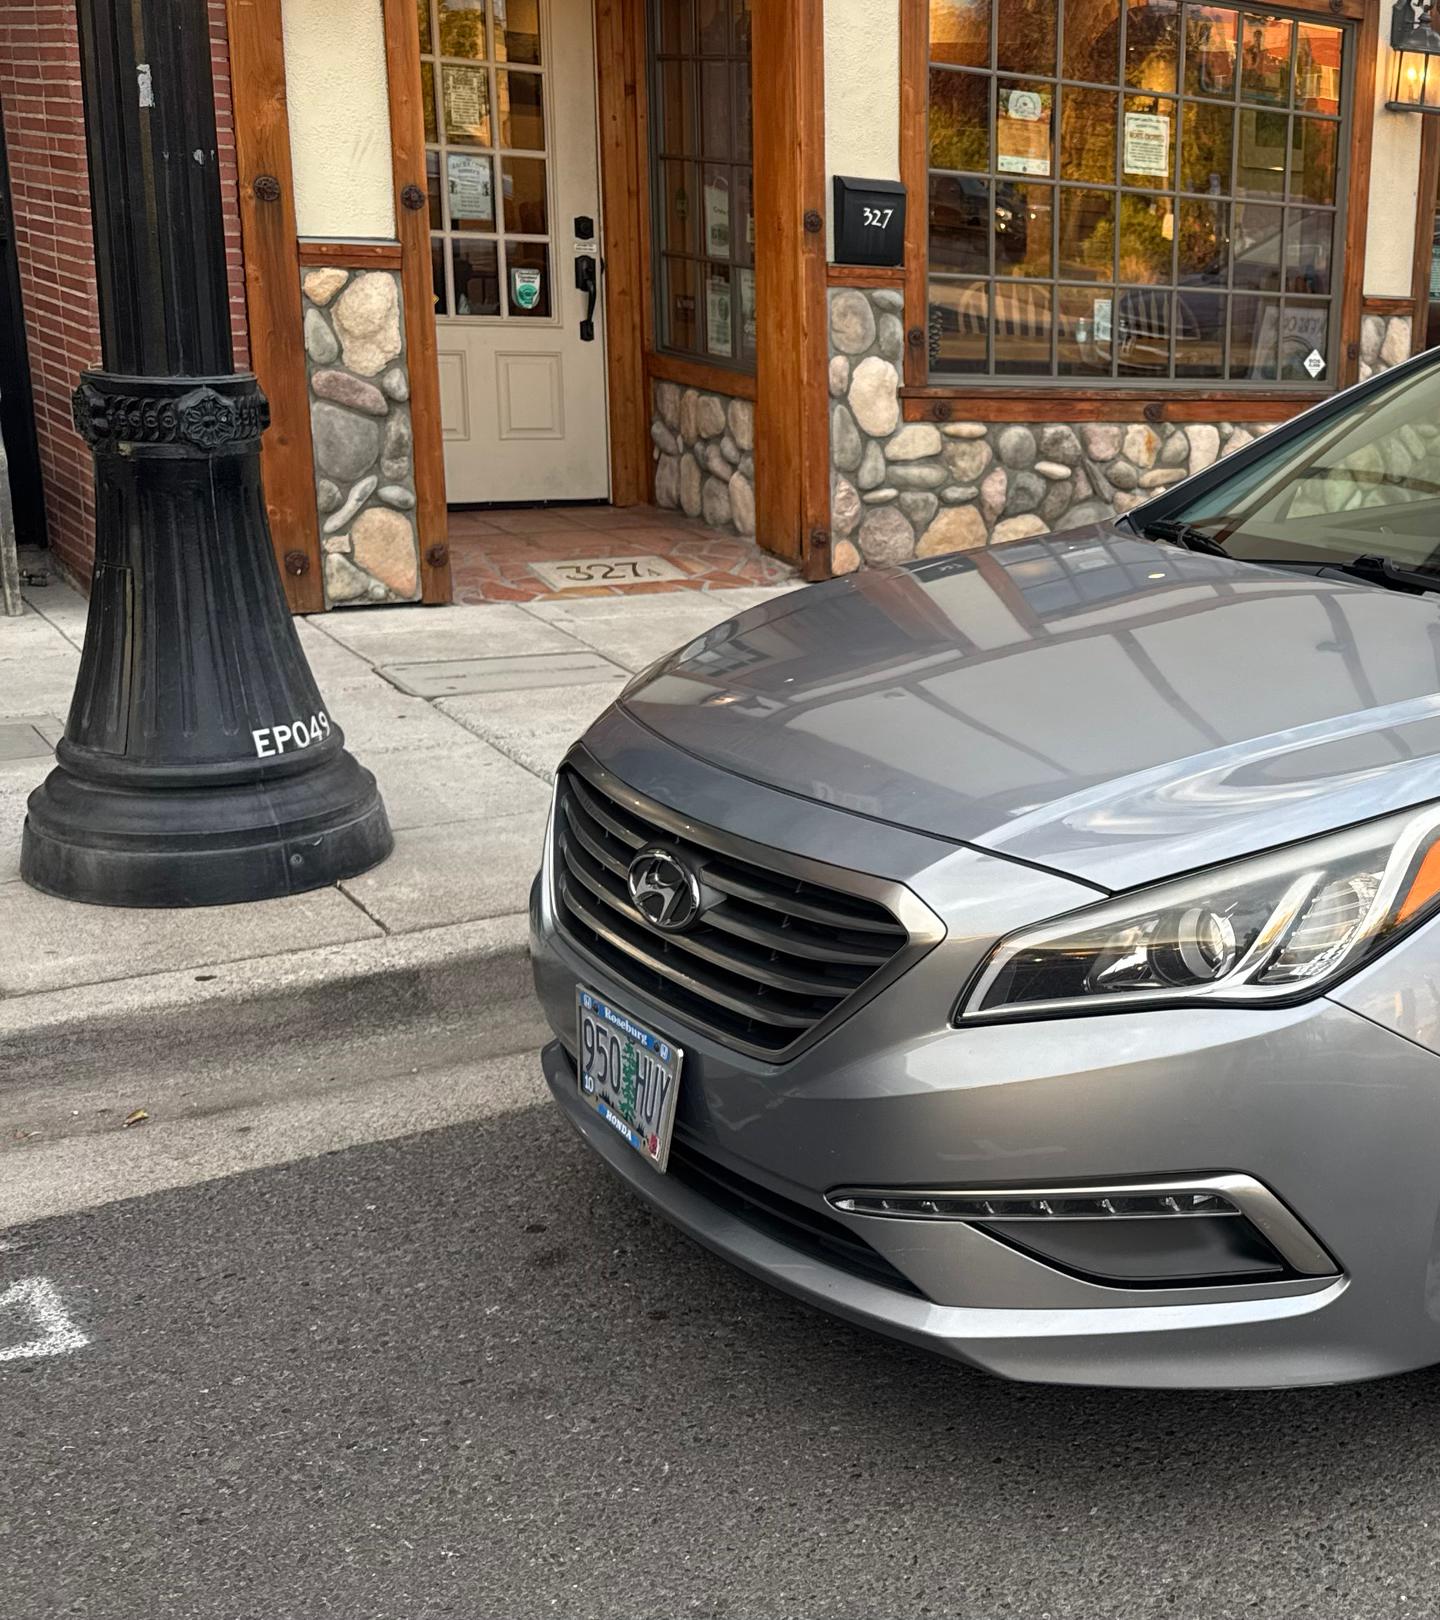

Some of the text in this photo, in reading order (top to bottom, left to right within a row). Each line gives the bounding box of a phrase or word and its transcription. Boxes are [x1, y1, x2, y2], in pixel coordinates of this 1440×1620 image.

[863, 207, 894, 229] 327
[252, 711, 331, 758] EP049
[604, 1006, 648, 1046] Roseburg
[583, 1016, 673, 1134] 950 HUY
[605, 1108, 633, 1141] HONDA
